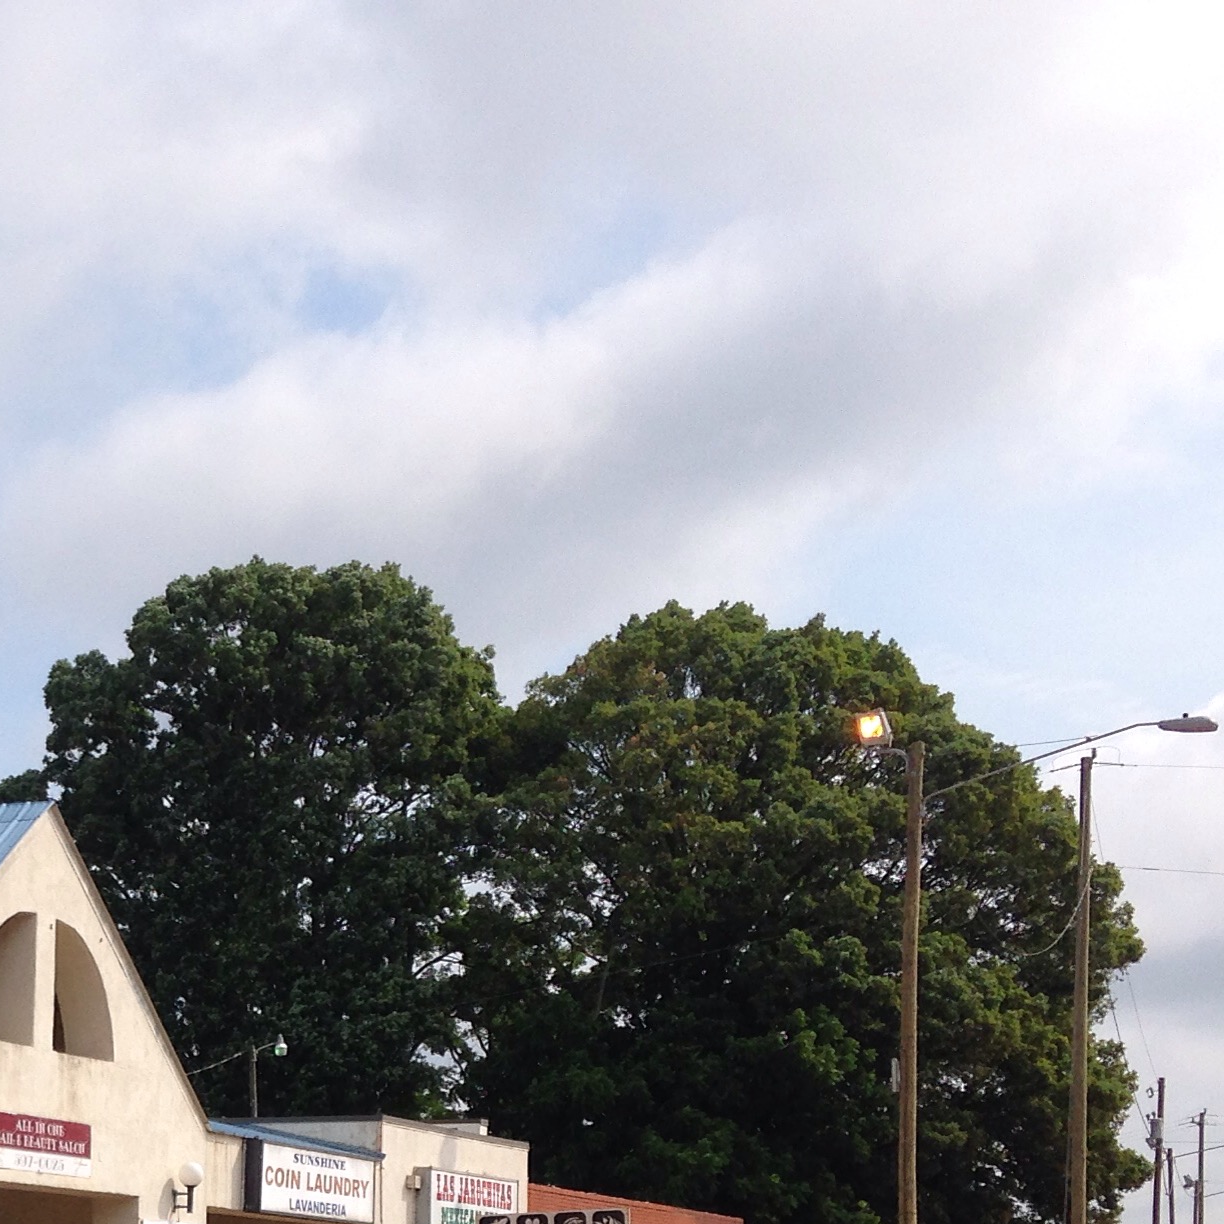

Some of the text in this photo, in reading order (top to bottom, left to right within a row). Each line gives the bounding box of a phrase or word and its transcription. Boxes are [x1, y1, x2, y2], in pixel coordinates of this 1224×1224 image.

[16, 1119, 65, 1137] ALL IN ONE
[23, 1134, 57, 1151] BEAUTY
[59, 1140, 85, 1155] SALON
[293, 1153, 346, 1171] SUNSHINE
[265, 1166, 369, 1198] COIN LAUNDRY
[436, 1173, 455, 1202] LAS
[289, 1198, 347, 1217] LAVANDERIA
